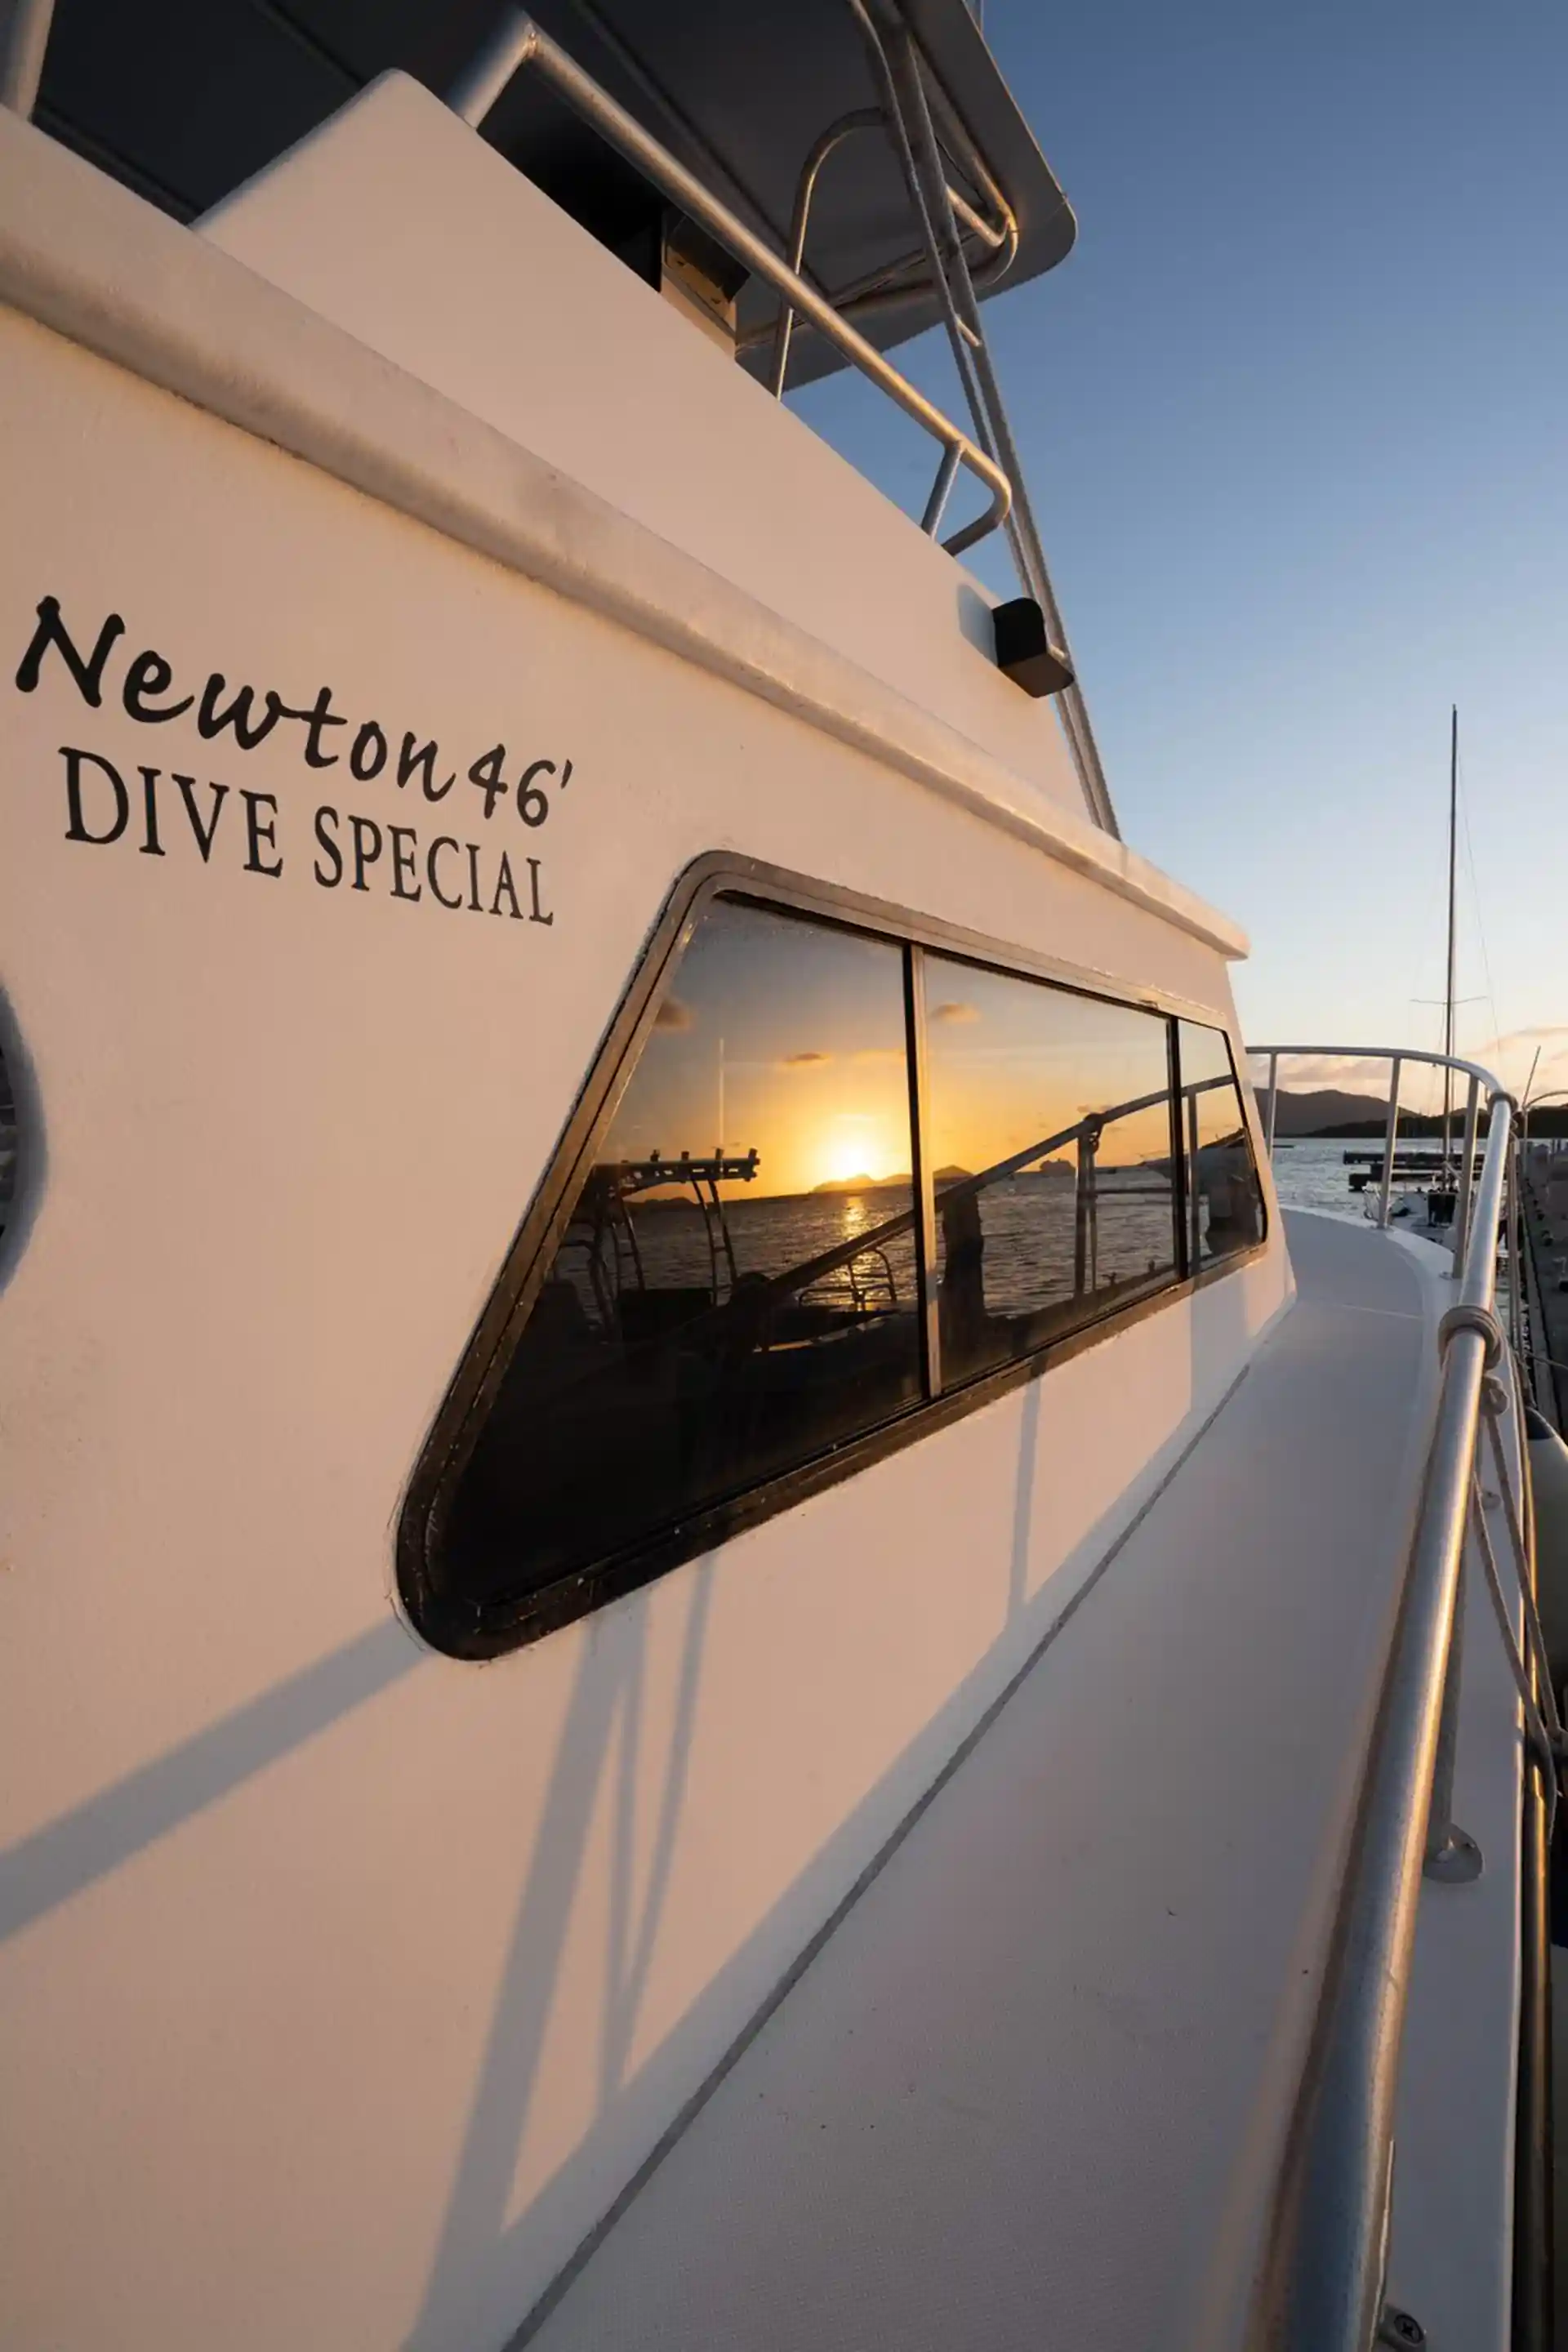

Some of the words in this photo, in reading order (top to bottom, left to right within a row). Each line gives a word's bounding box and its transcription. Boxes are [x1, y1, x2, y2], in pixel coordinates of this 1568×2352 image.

[15, 595, 457, 803] Newton
[468, 743, 573, 828] 46'
[57, 746, 283, 879] DIVE
[314, 805, 554, 926] SPECIAL
